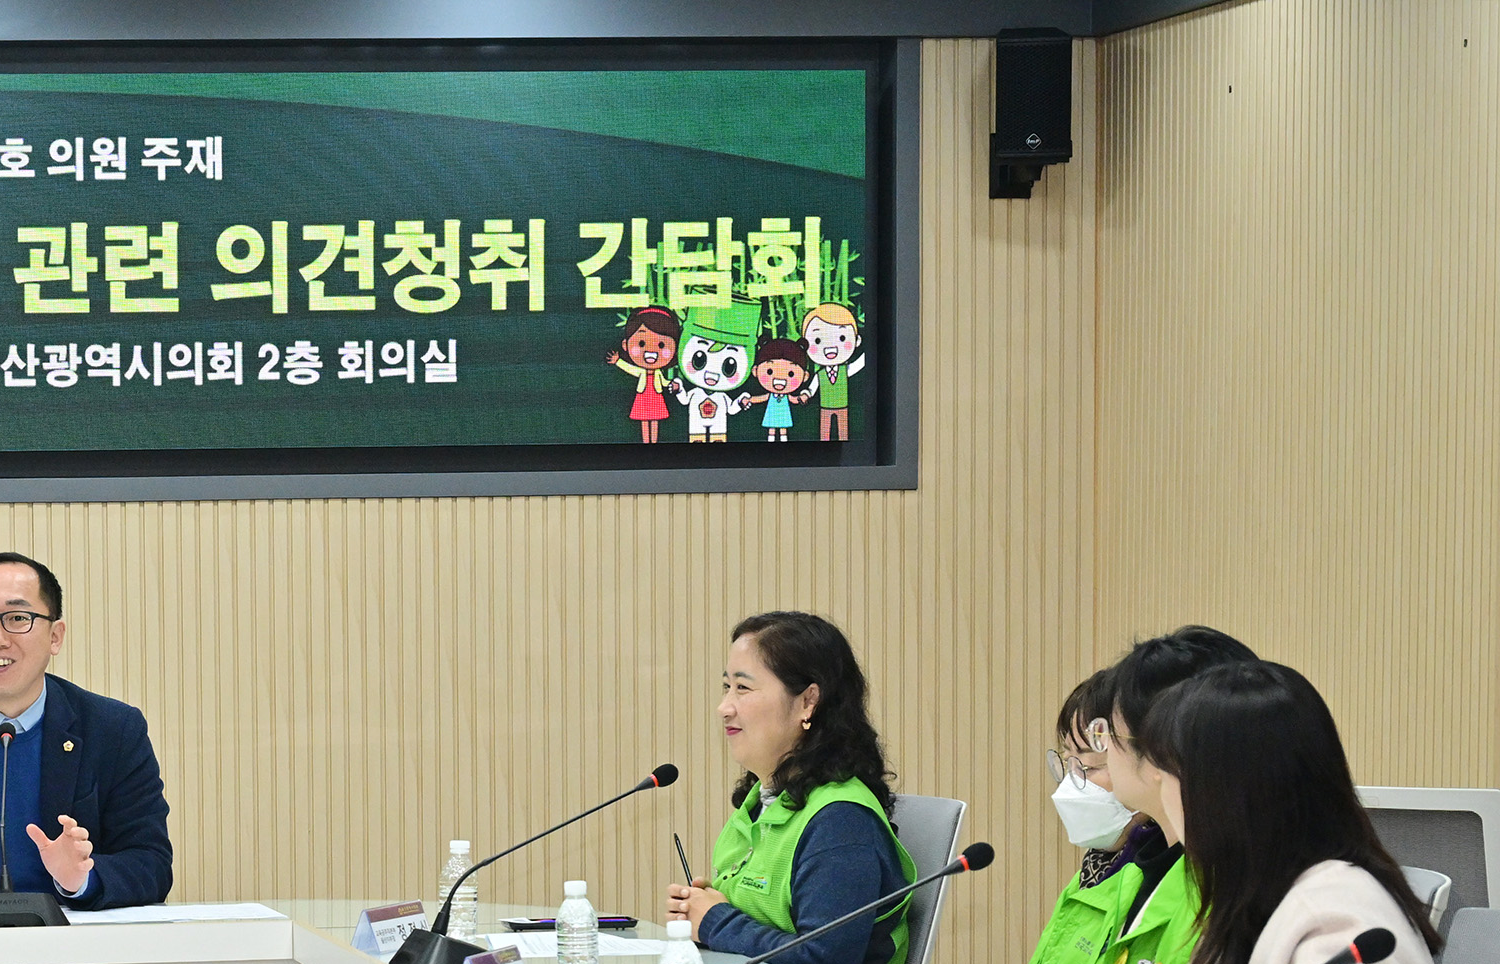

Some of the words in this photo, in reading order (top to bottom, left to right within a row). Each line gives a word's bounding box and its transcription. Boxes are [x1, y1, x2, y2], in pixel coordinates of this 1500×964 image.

[47, 137, 128, 182] 의원
[141, 136, 224, 181] 주재
[13, 221, 180, 314] 관련
[210, 218, 546, 314] 의견청취
[576, 216, 821, 312] 간담회
[258, 340, 324, 387] 2층
[337, 338, 459, 384] 회의실
